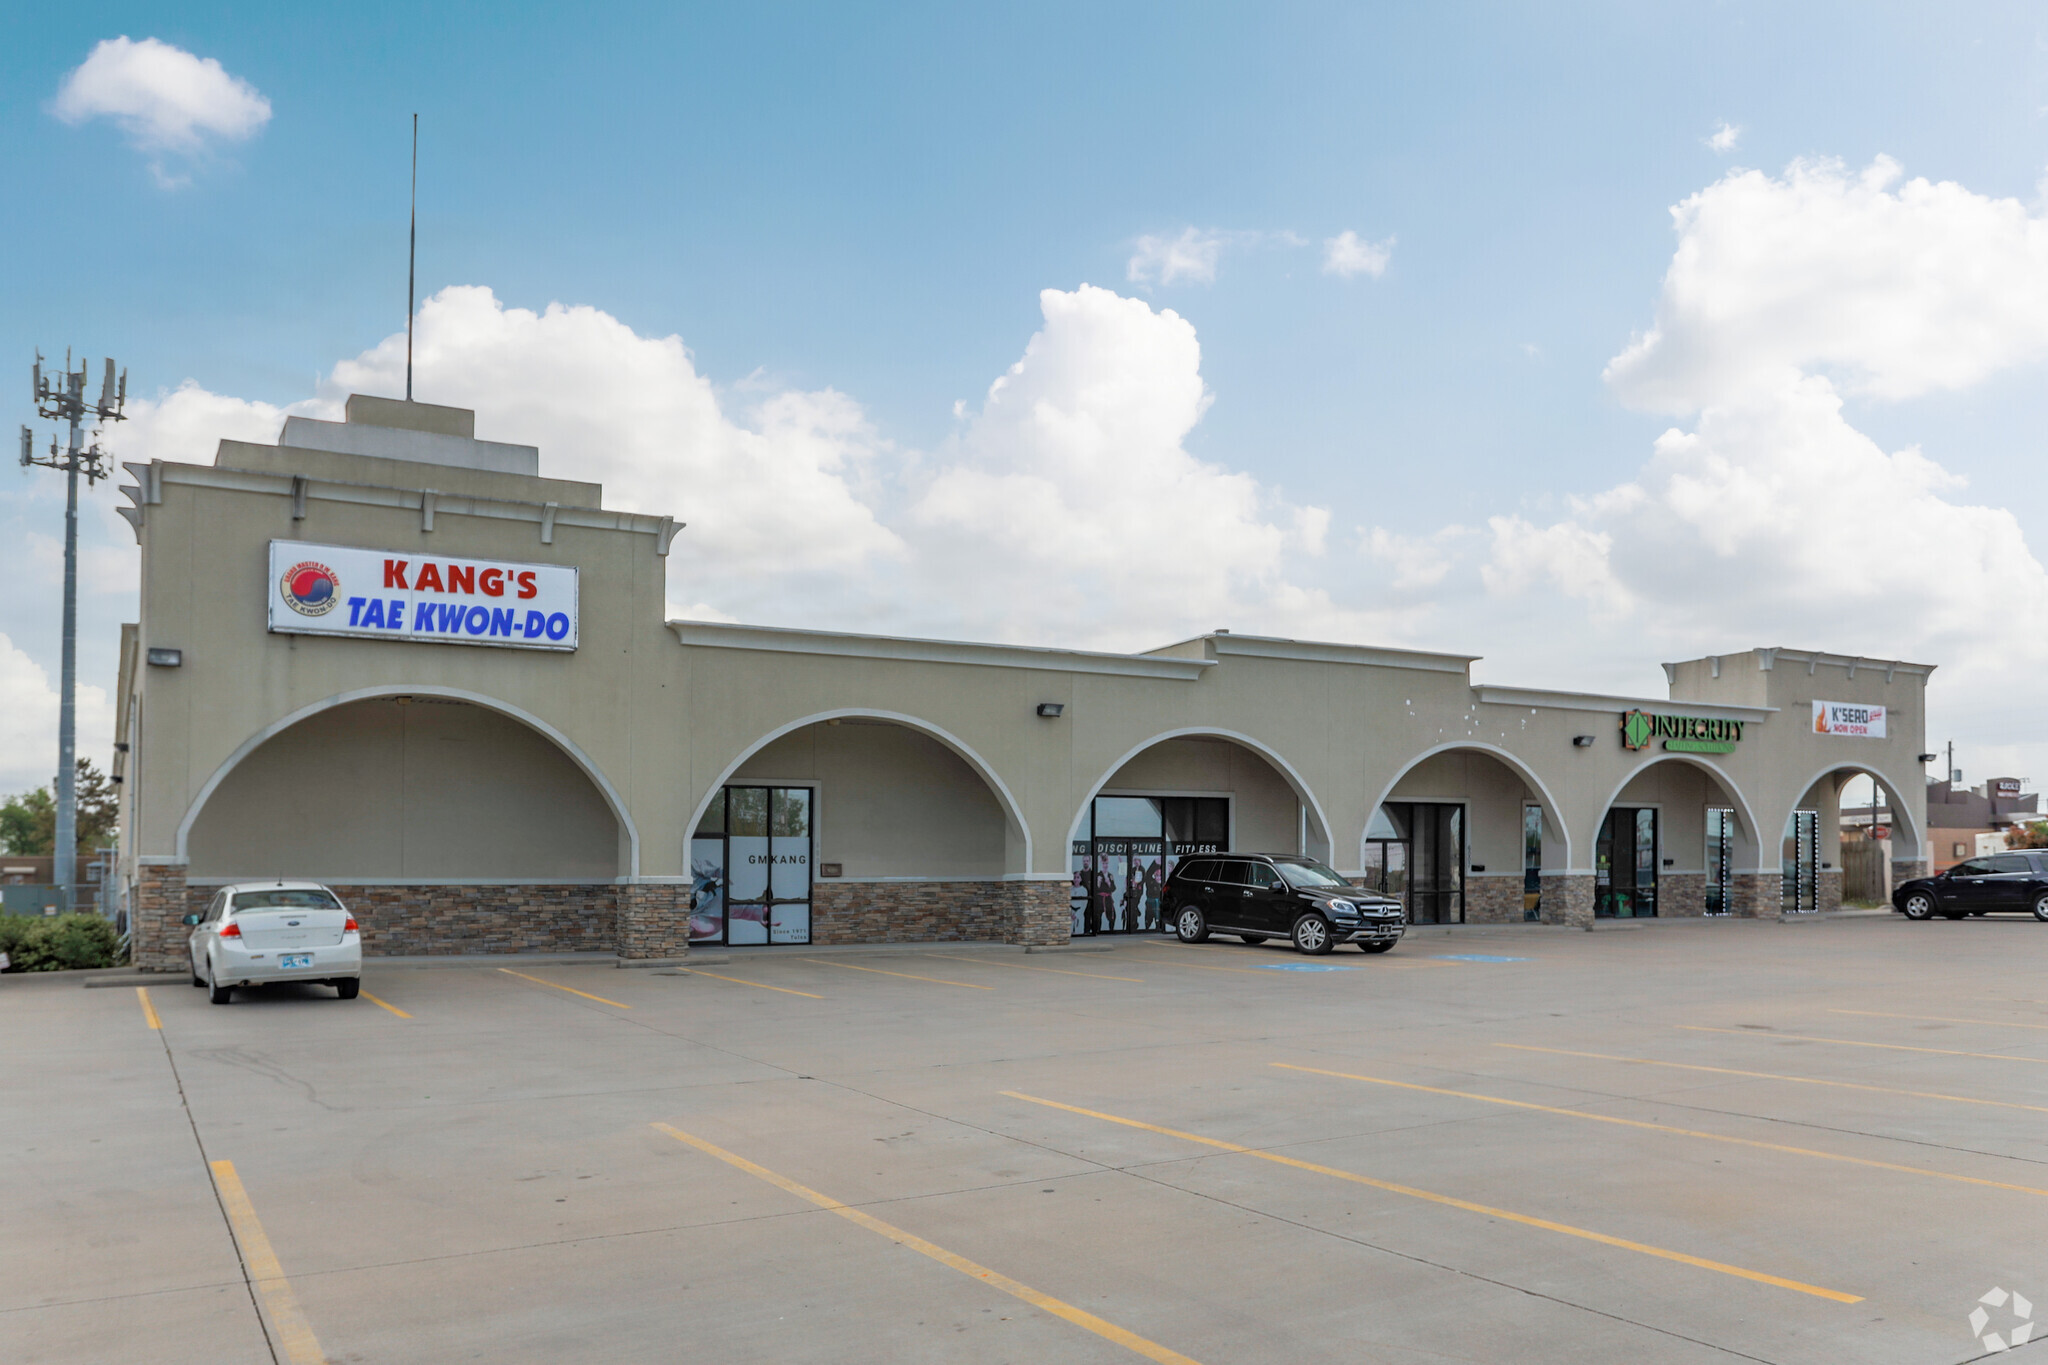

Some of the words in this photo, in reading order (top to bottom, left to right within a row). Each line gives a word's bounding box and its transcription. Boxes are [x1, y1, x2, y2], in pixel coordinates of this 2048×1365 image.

[383, 559, 538, 600] KANG'S
[285, 593, 299, 608] TAE
[299, 597, 337, 614] KWON-DO
[347, 596, 406, 630] TAE
[413, 602, 570, 641] KWON-DO
[1655, 714, 1744, 742] INTEGRITY
[1833, 724, 1848, 733] NOW
[1850, 725, 1868, 734] OPEN
[1097, 843, 1162, 853] DISCIPLINE
